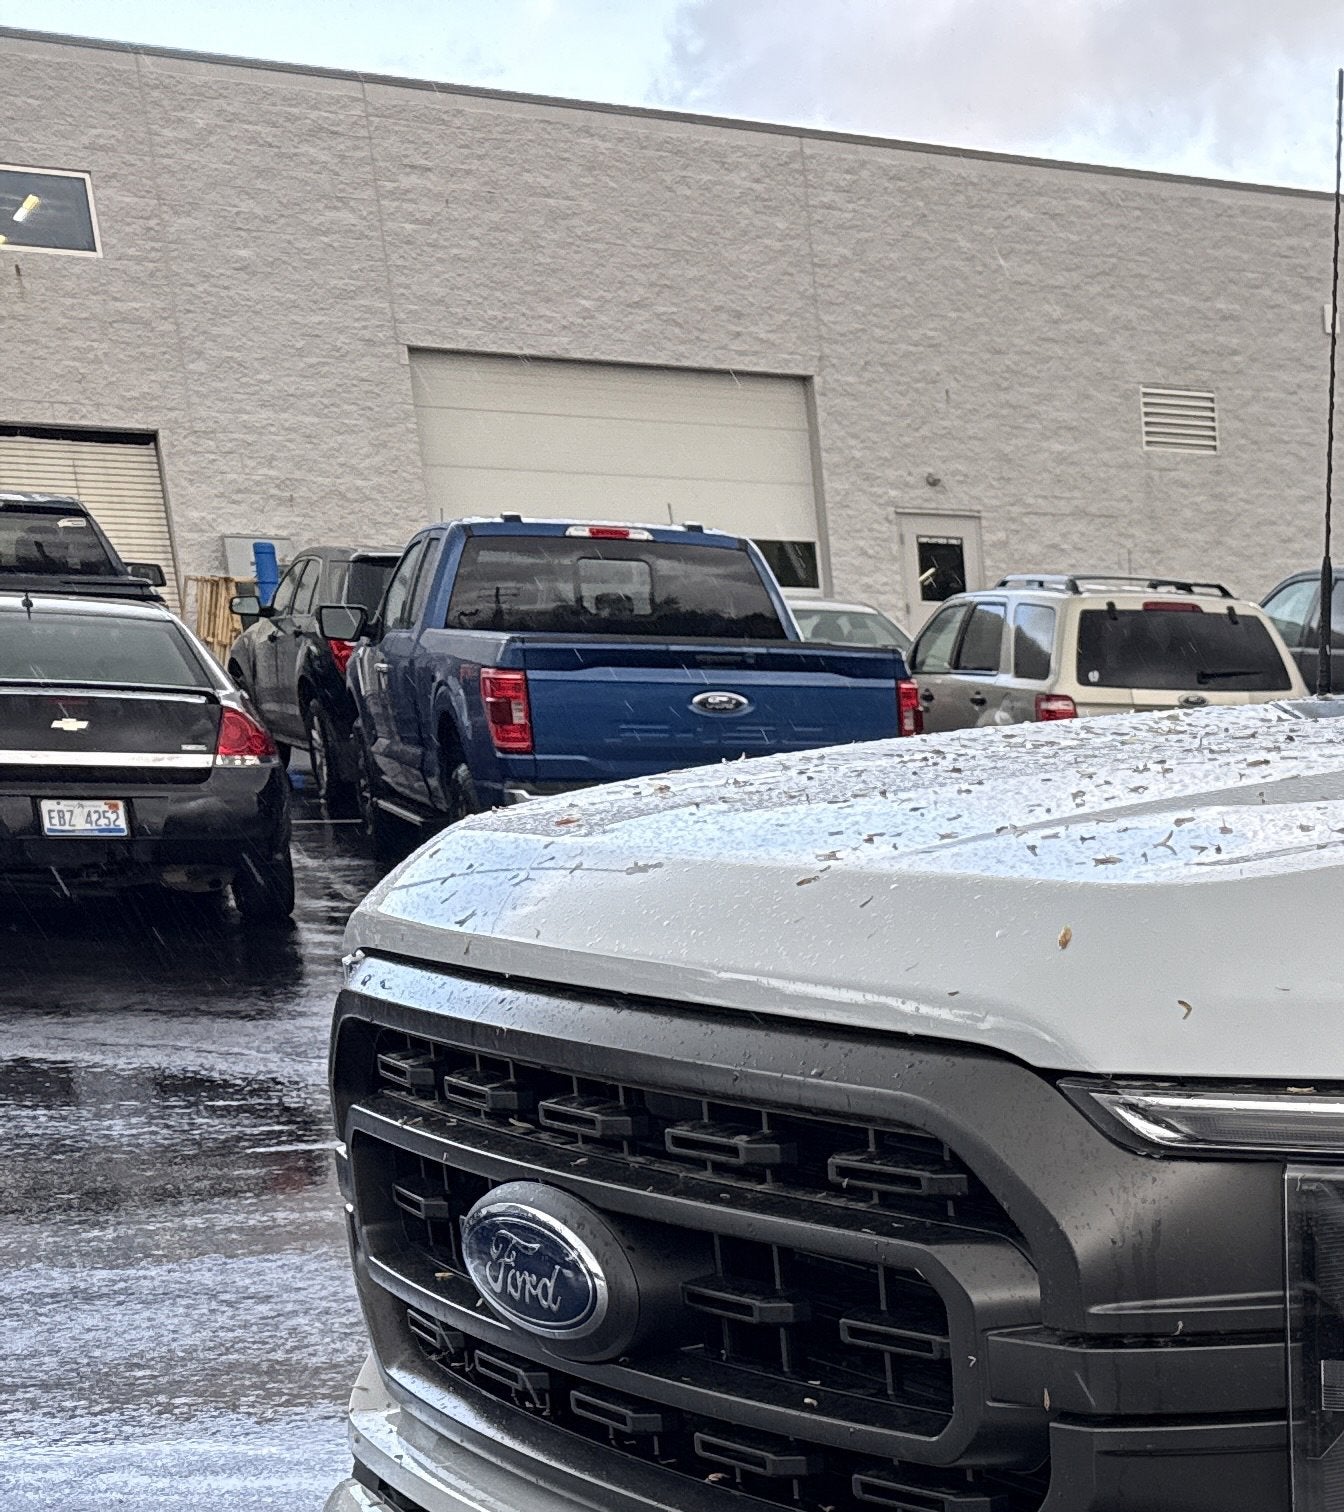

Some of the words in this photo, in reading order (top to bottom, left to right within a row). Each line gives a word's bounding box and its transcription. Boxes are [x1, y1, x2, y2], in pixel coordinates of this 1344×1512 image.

[47, 809, 76, 828] EBZ
[85, 809, 122, 828] 4252
[485, 1229, 562, 1313] Ford
